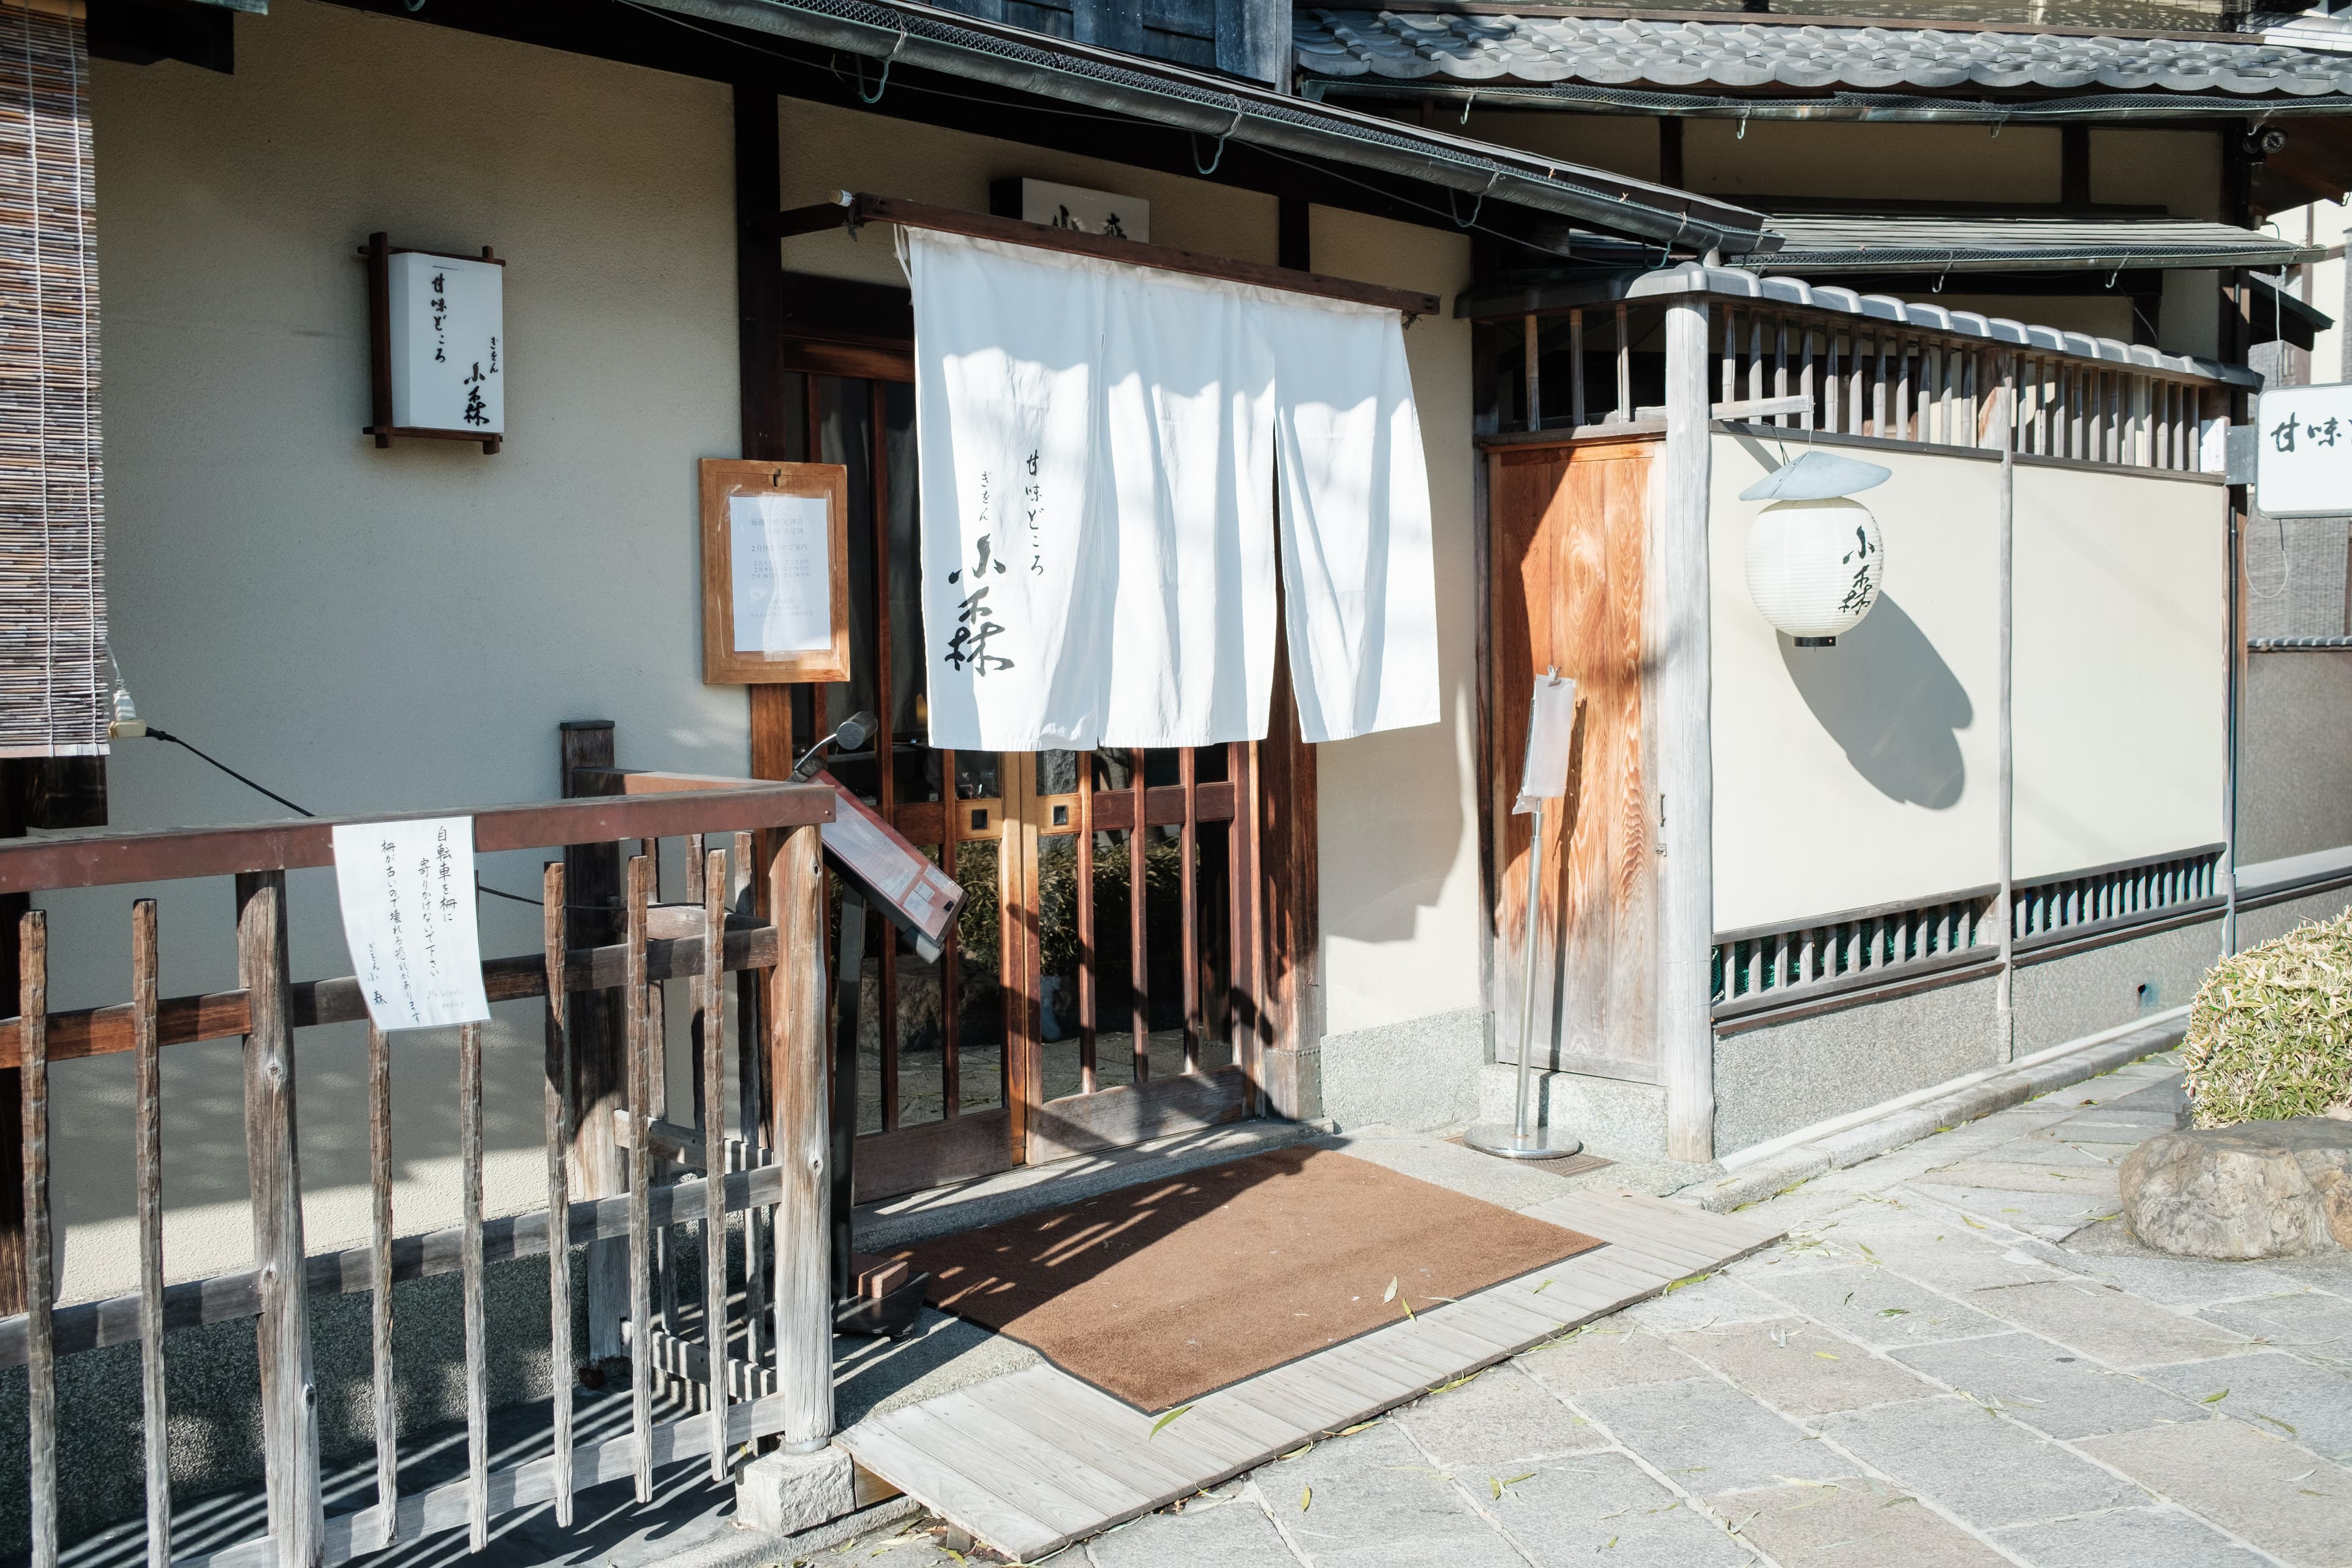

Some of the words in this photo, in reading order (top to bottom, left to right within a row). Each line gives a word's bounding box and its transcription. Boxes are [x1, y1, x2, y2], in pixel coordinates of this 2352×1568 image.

[431, 273, 447, 363] 甘味どころ
[463, 362, 491, 426] 小森
[2270, 412, 2352, 452] 甘味
[979, 470, 992, 521] ぎをん
[1025, 449, 1044, 576] 甘味どころ
[944, 533, 1015, 677] 小森
[1838, 524, 1875, 616] 小森
[418, 857, 439, 977] 寄りかけないで下さい
[435, 825, 458, 922] 自転車を柵に
